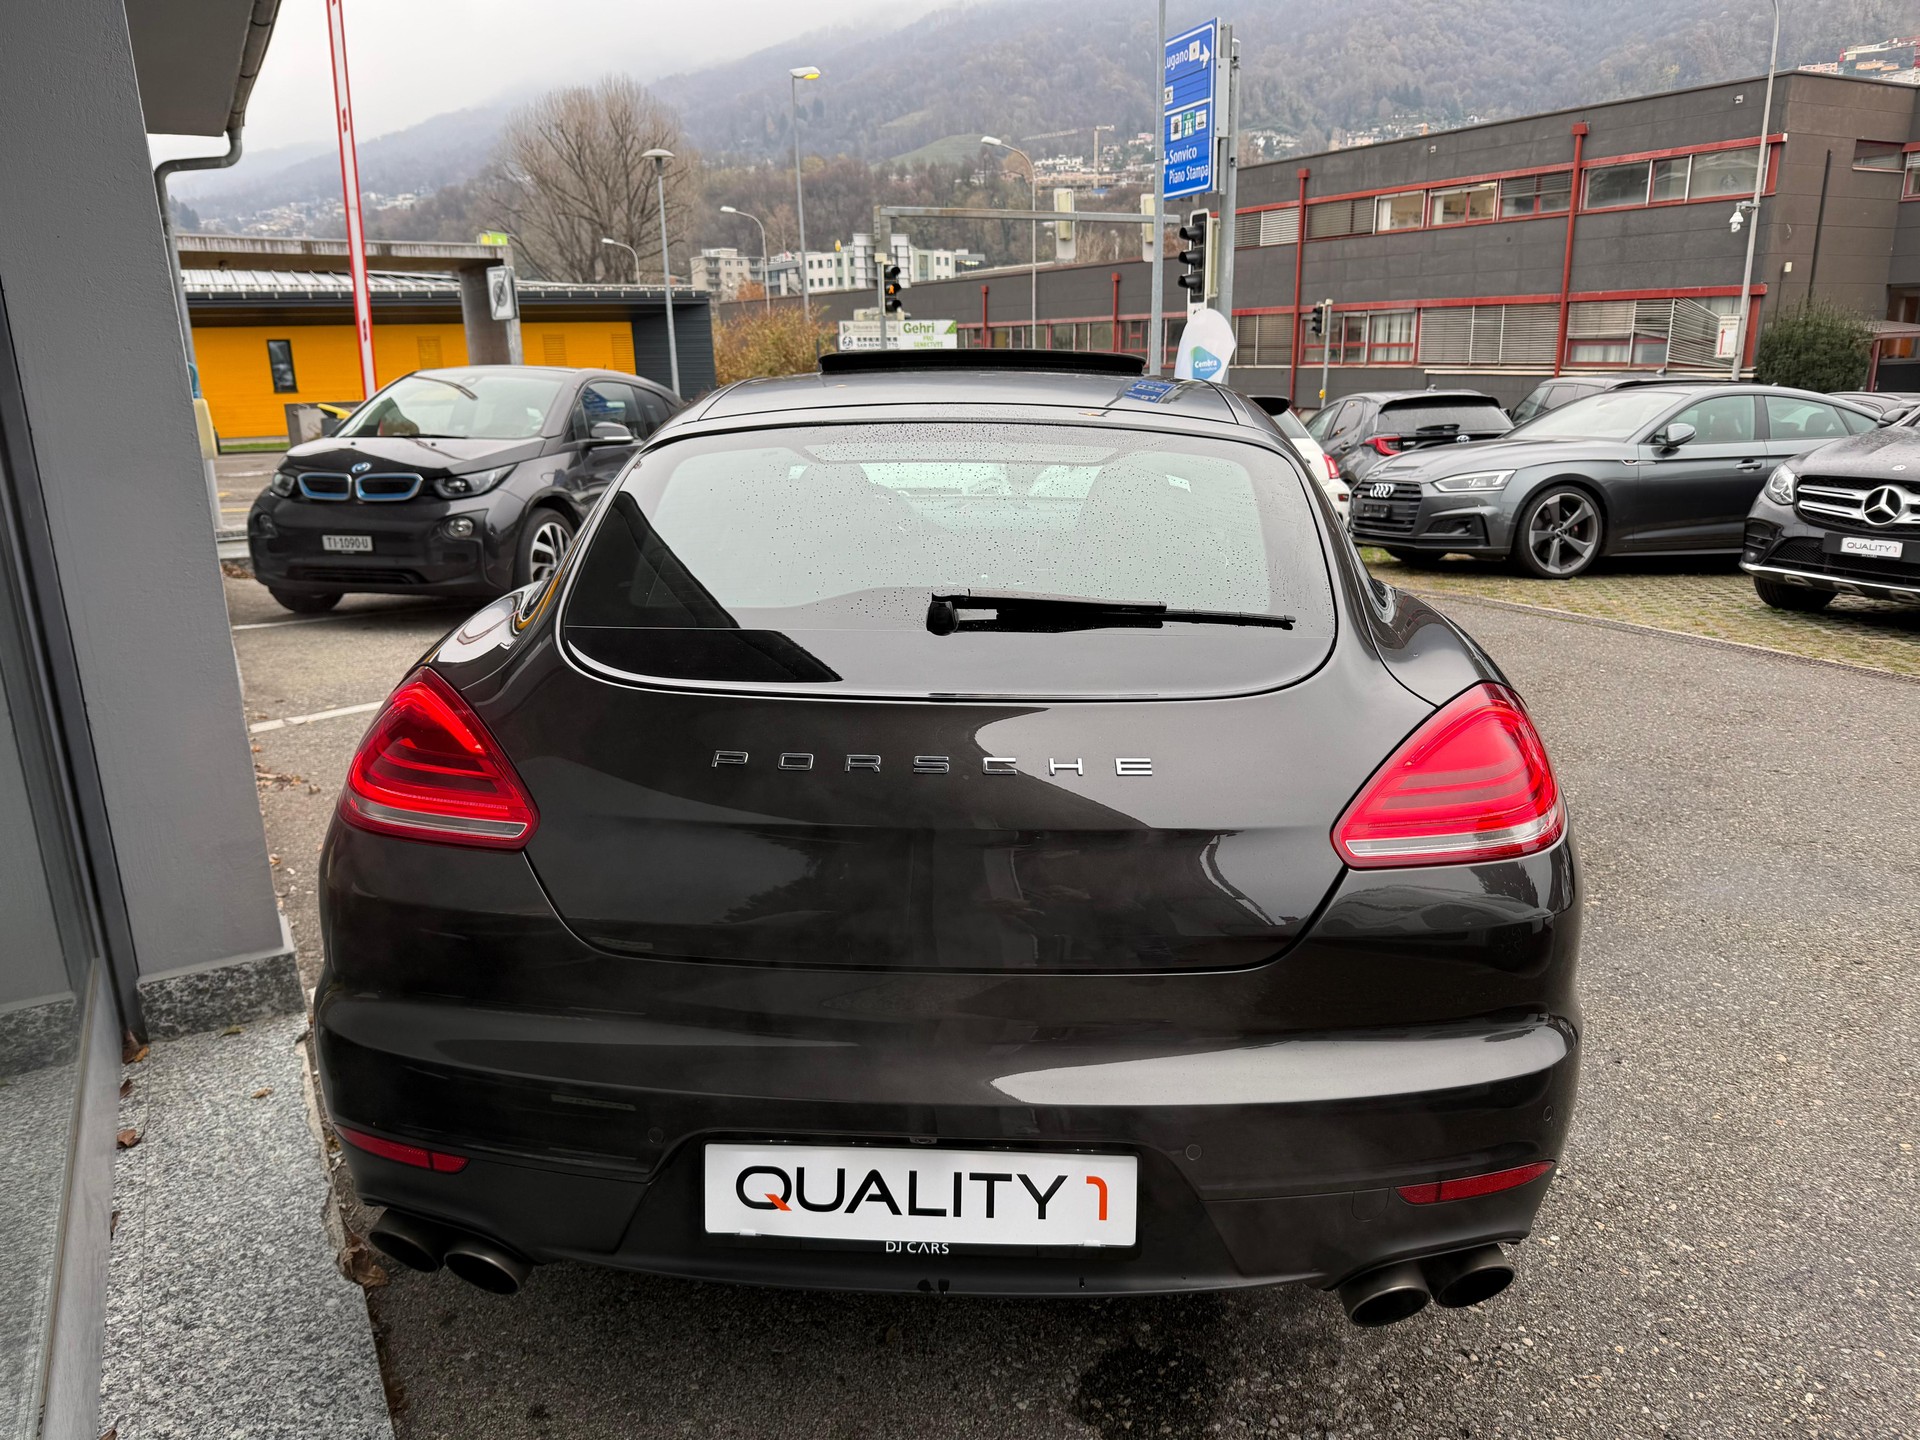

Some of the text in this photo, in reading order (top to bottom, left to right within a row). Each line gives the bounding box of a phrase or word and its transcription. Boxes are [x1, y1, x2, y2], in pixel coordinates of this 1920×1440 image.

[1164, 49, 1189, 71] ugano
[1169, 145, 1197, 165] Sonvico
[1169, 164, 1209, 185] Piano Stampa
[903, 322, 935, 334] Gehri
[1194, 359, 1217, 368] Cembra
[711, 750, 1153, 776] PORSCHE
[735, 1165, 1108, 1221] QUALITY 1
[885, 1240, 950, 1255] DJ CARS
